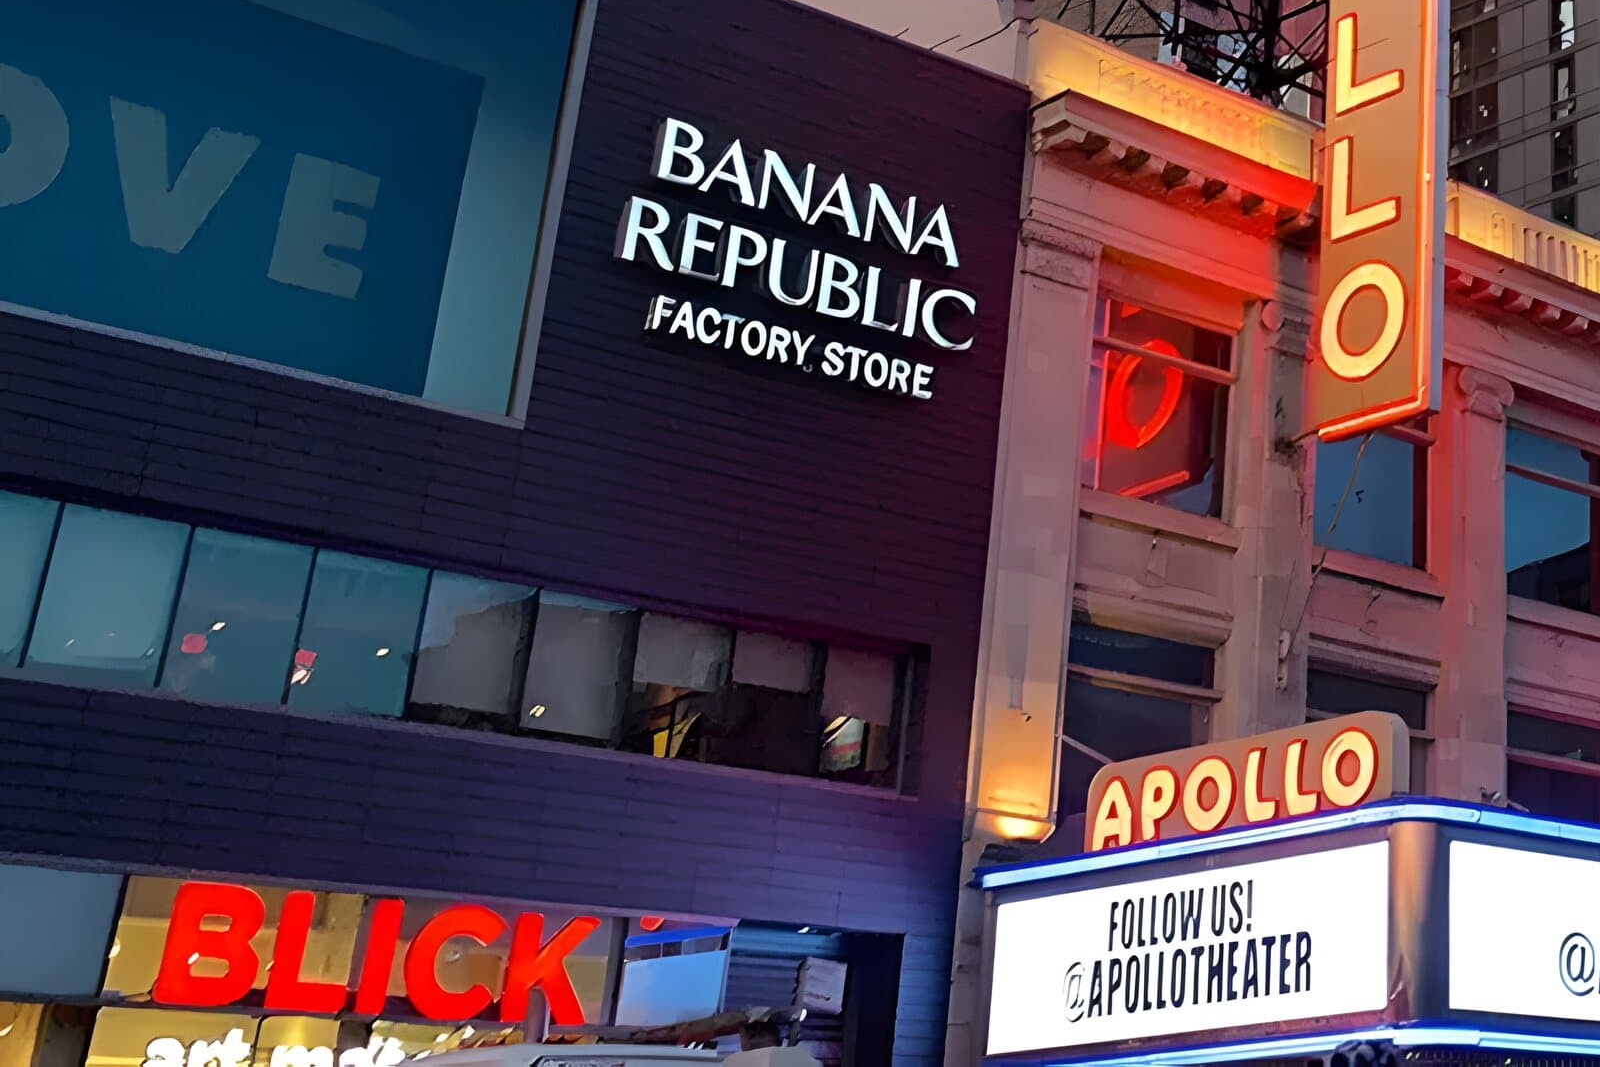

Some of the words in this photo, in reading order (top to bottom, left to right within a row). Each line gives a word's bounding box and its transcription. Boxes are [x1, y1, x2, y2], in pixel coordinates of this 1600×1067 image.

[654, 117, 960, 268] BANANA
[617, 195, 977, 350] REPUBLIC
[648, 295, 816, 365] FACTORY
[821, 341, 935, 400] STORE
[1090, 726, 1379, 851] APOLLO
[152, 881, 600, 1026] BLICK
[1063, 931, 1312, 1023] @APOLLOTHEATER
[1107, 887, 1204, 952] FOLLOW
[1210, 879, 1255, 937] US!
